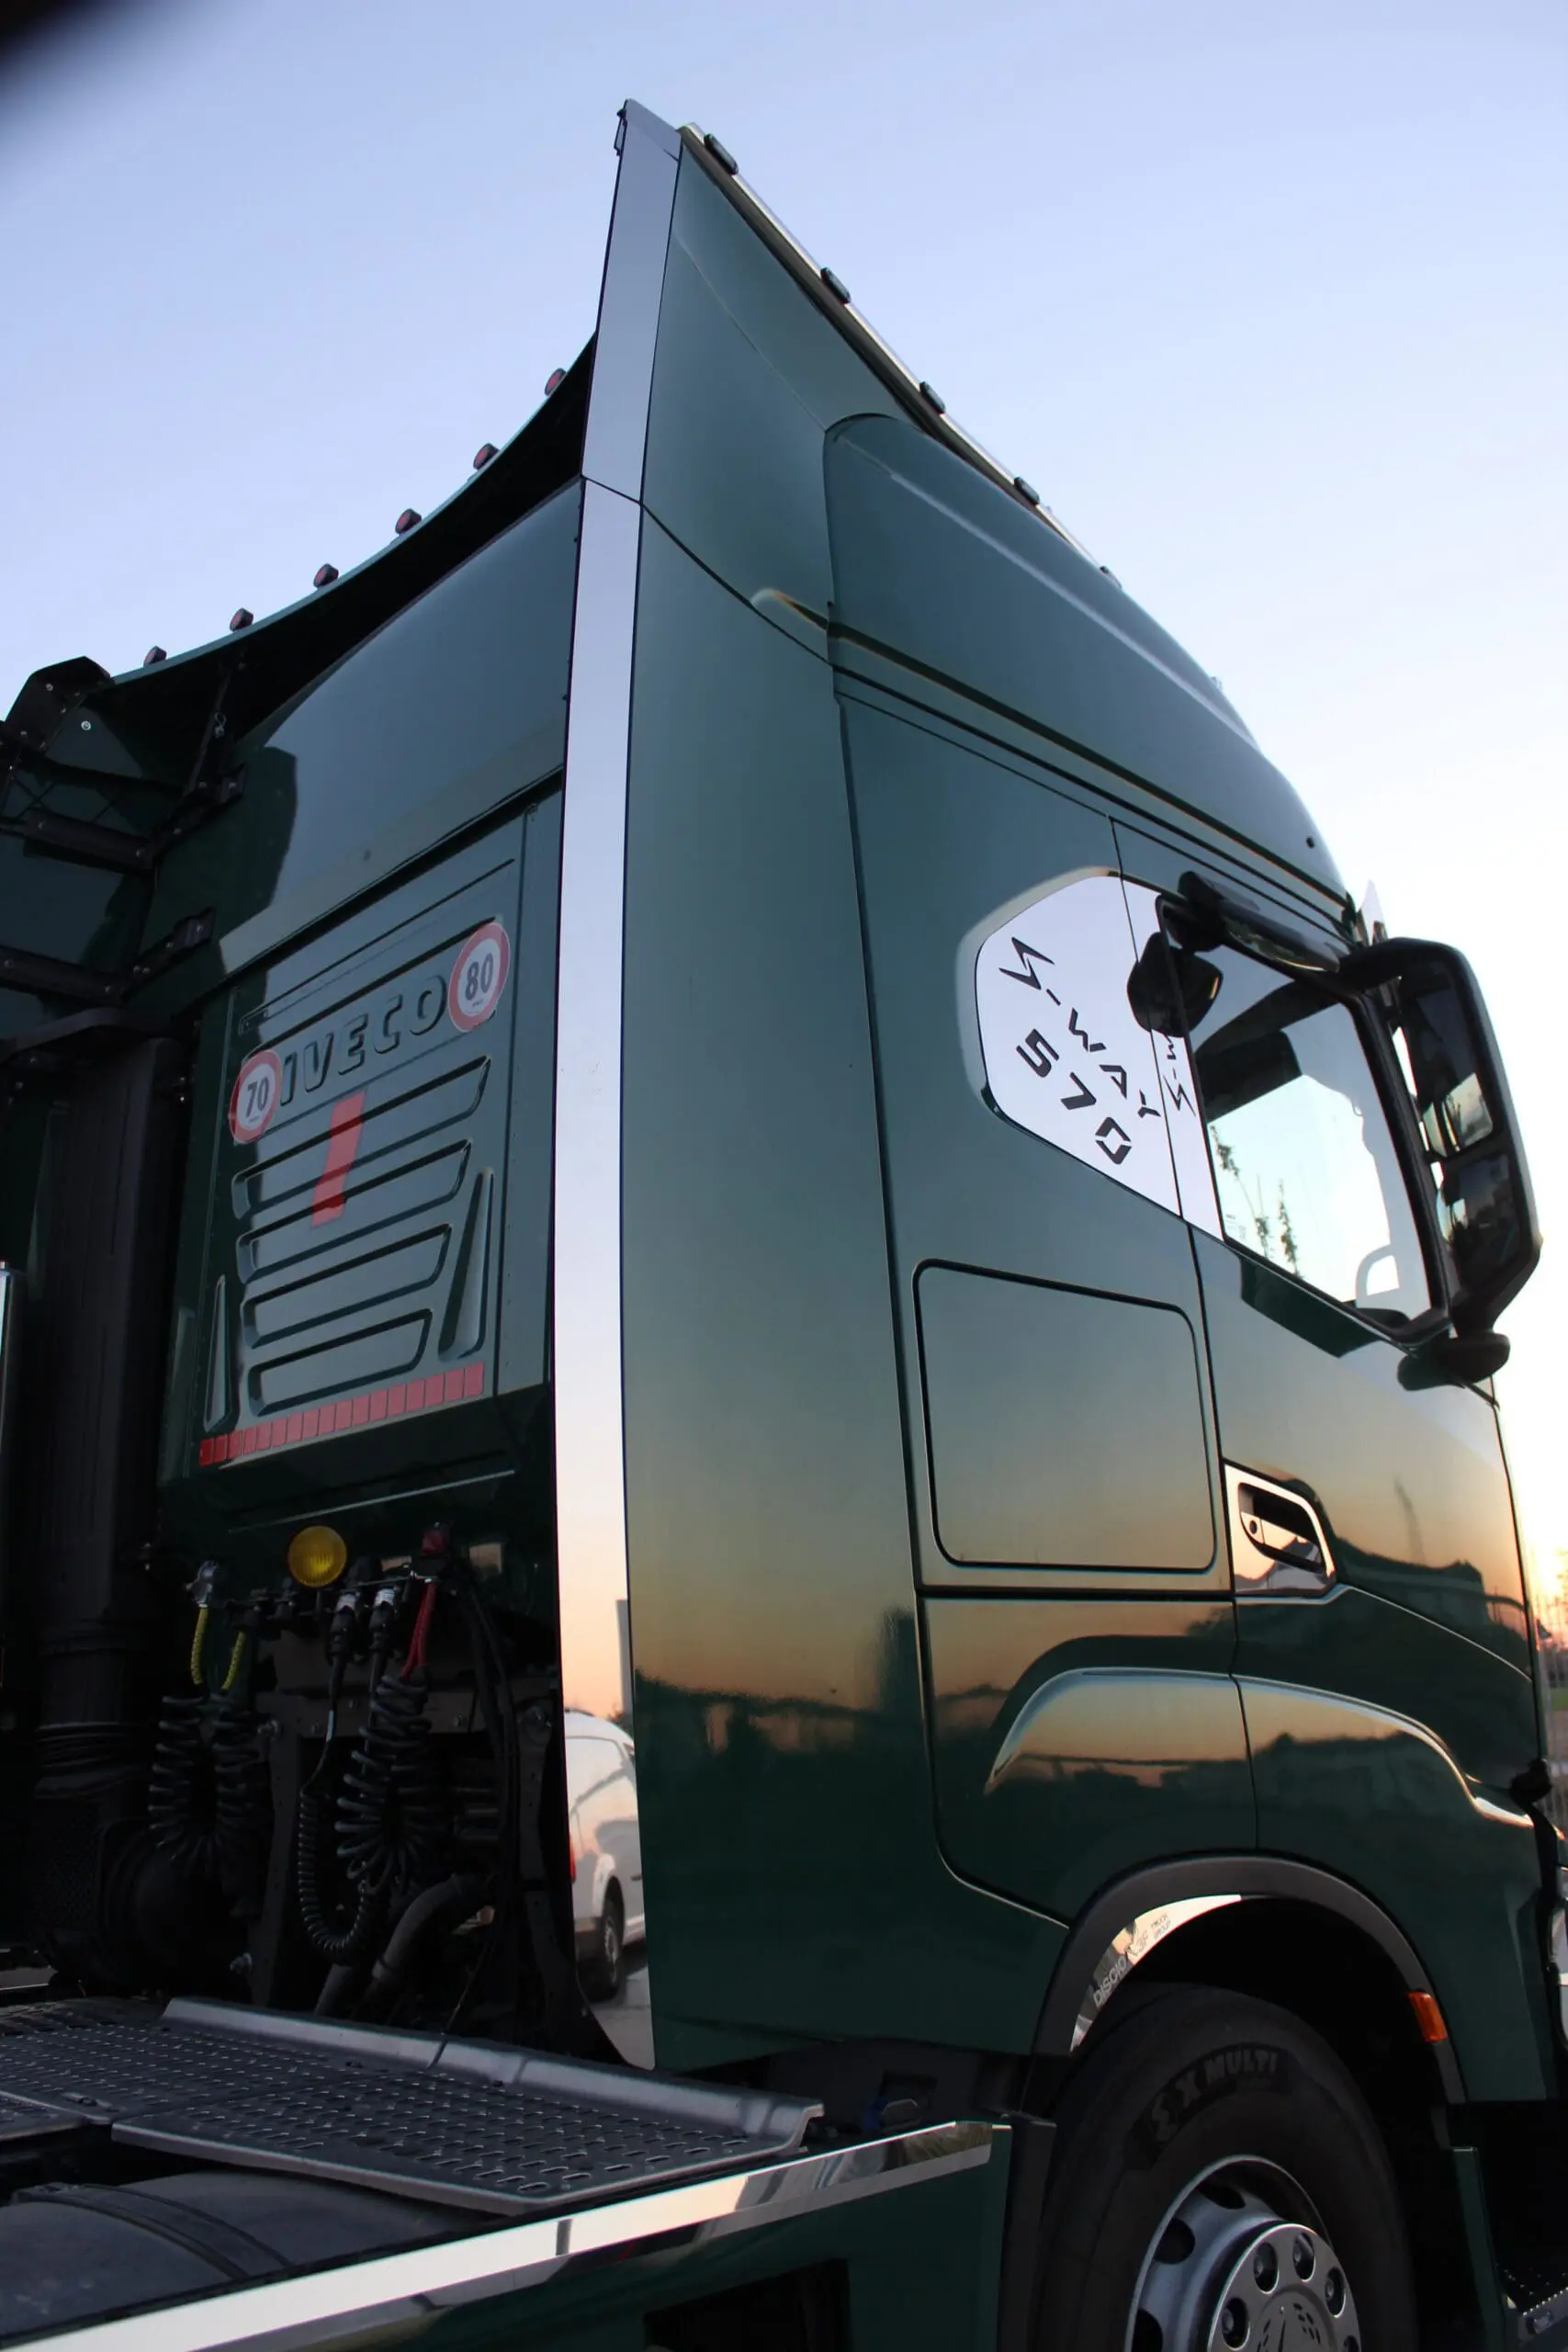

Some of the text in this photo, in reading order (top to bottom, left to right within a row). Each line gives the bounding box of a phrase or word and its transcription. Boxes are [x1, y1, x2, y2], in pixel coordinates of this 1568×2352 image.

[465, 953, 494, 1001] 80
[278, 974, 447, 1108] IVECO
[998, 936, 1162, 1118] S-WAY
[245, 1076, 270, 1118] 70
[1015, 1028, 1133, 1165] 570
[1202, 2049, 1279, 2086] MULTI
